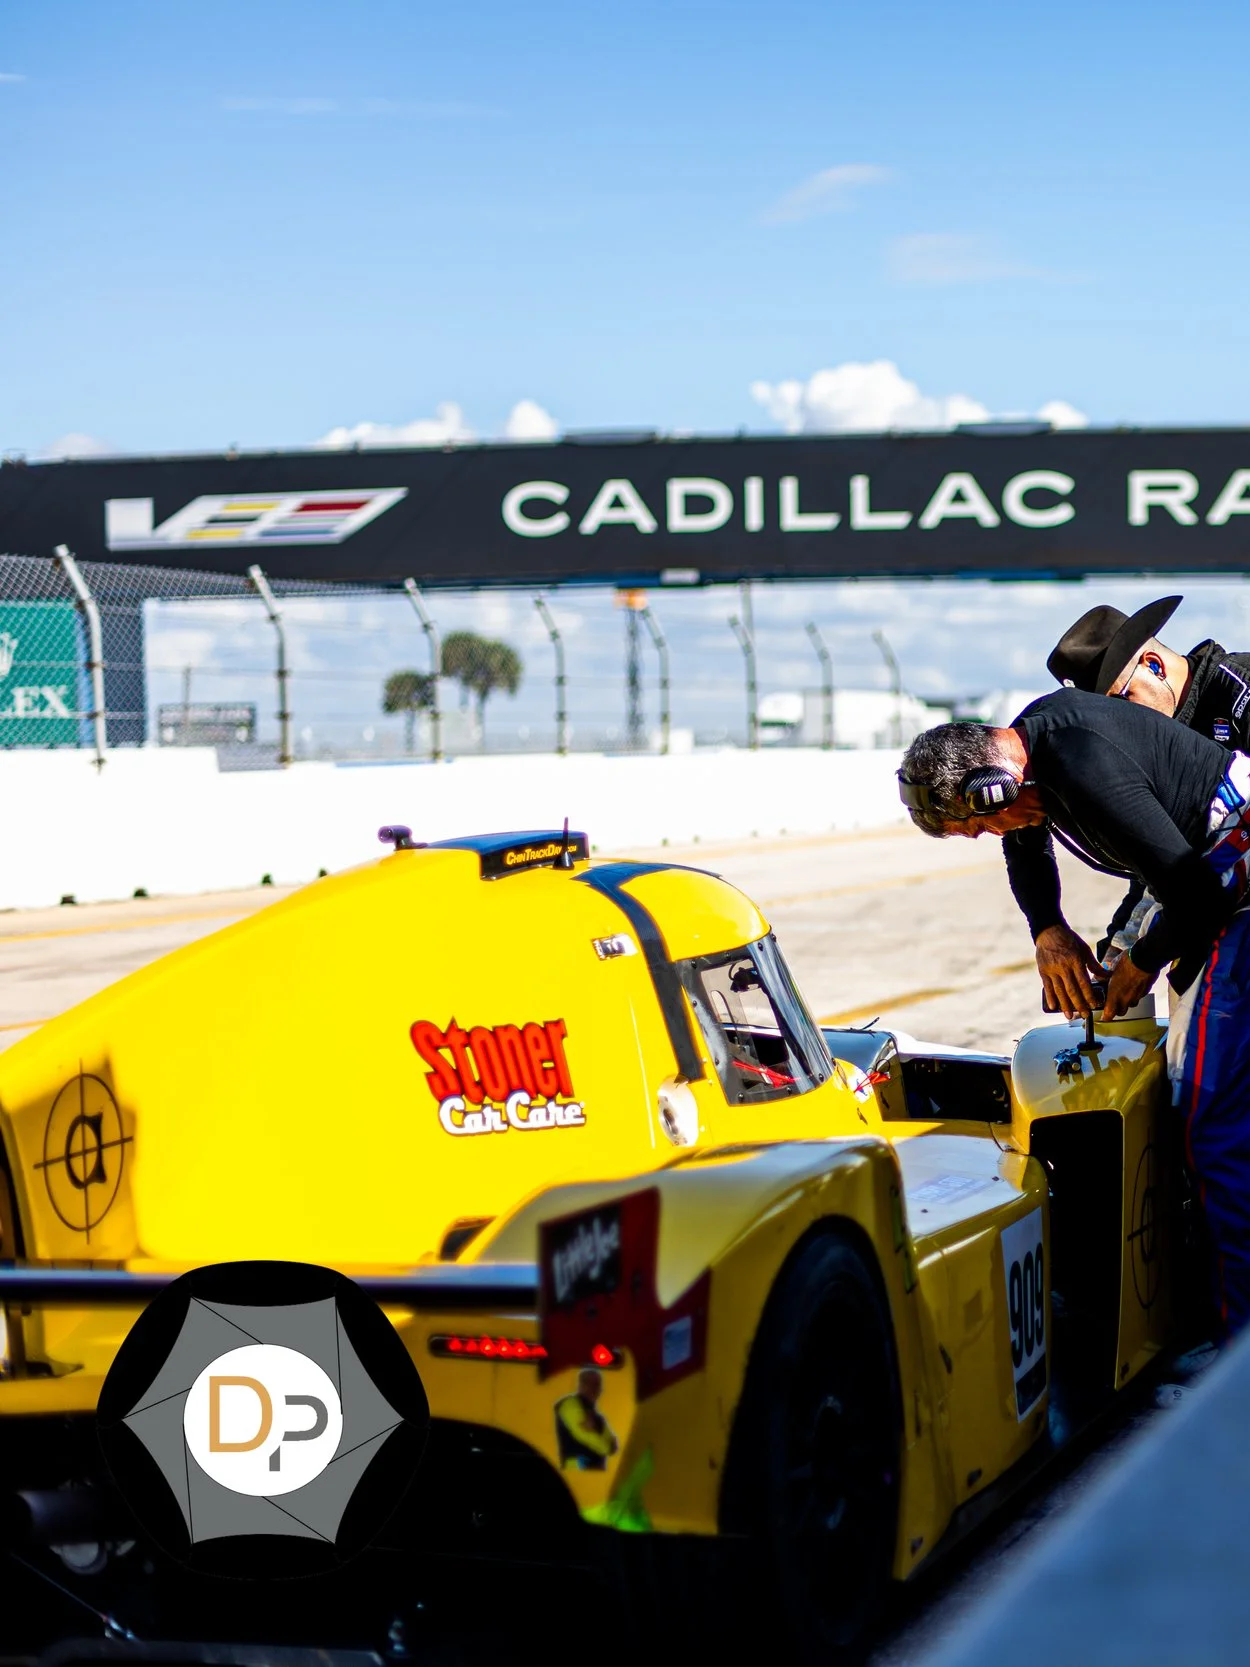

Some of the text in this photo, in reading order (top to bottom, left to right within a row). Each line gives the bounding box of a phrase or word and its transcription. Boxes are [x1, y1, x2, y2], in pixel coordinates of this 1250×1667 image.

[500, 470, 1077, 538] CADILLAC
[0, 686, 70, 718] EX
[410, 1015, 575, 1105] Stoner
[438, 1094, 509, 1137] Car
[1009, 1242, 1043, 1368] 909
